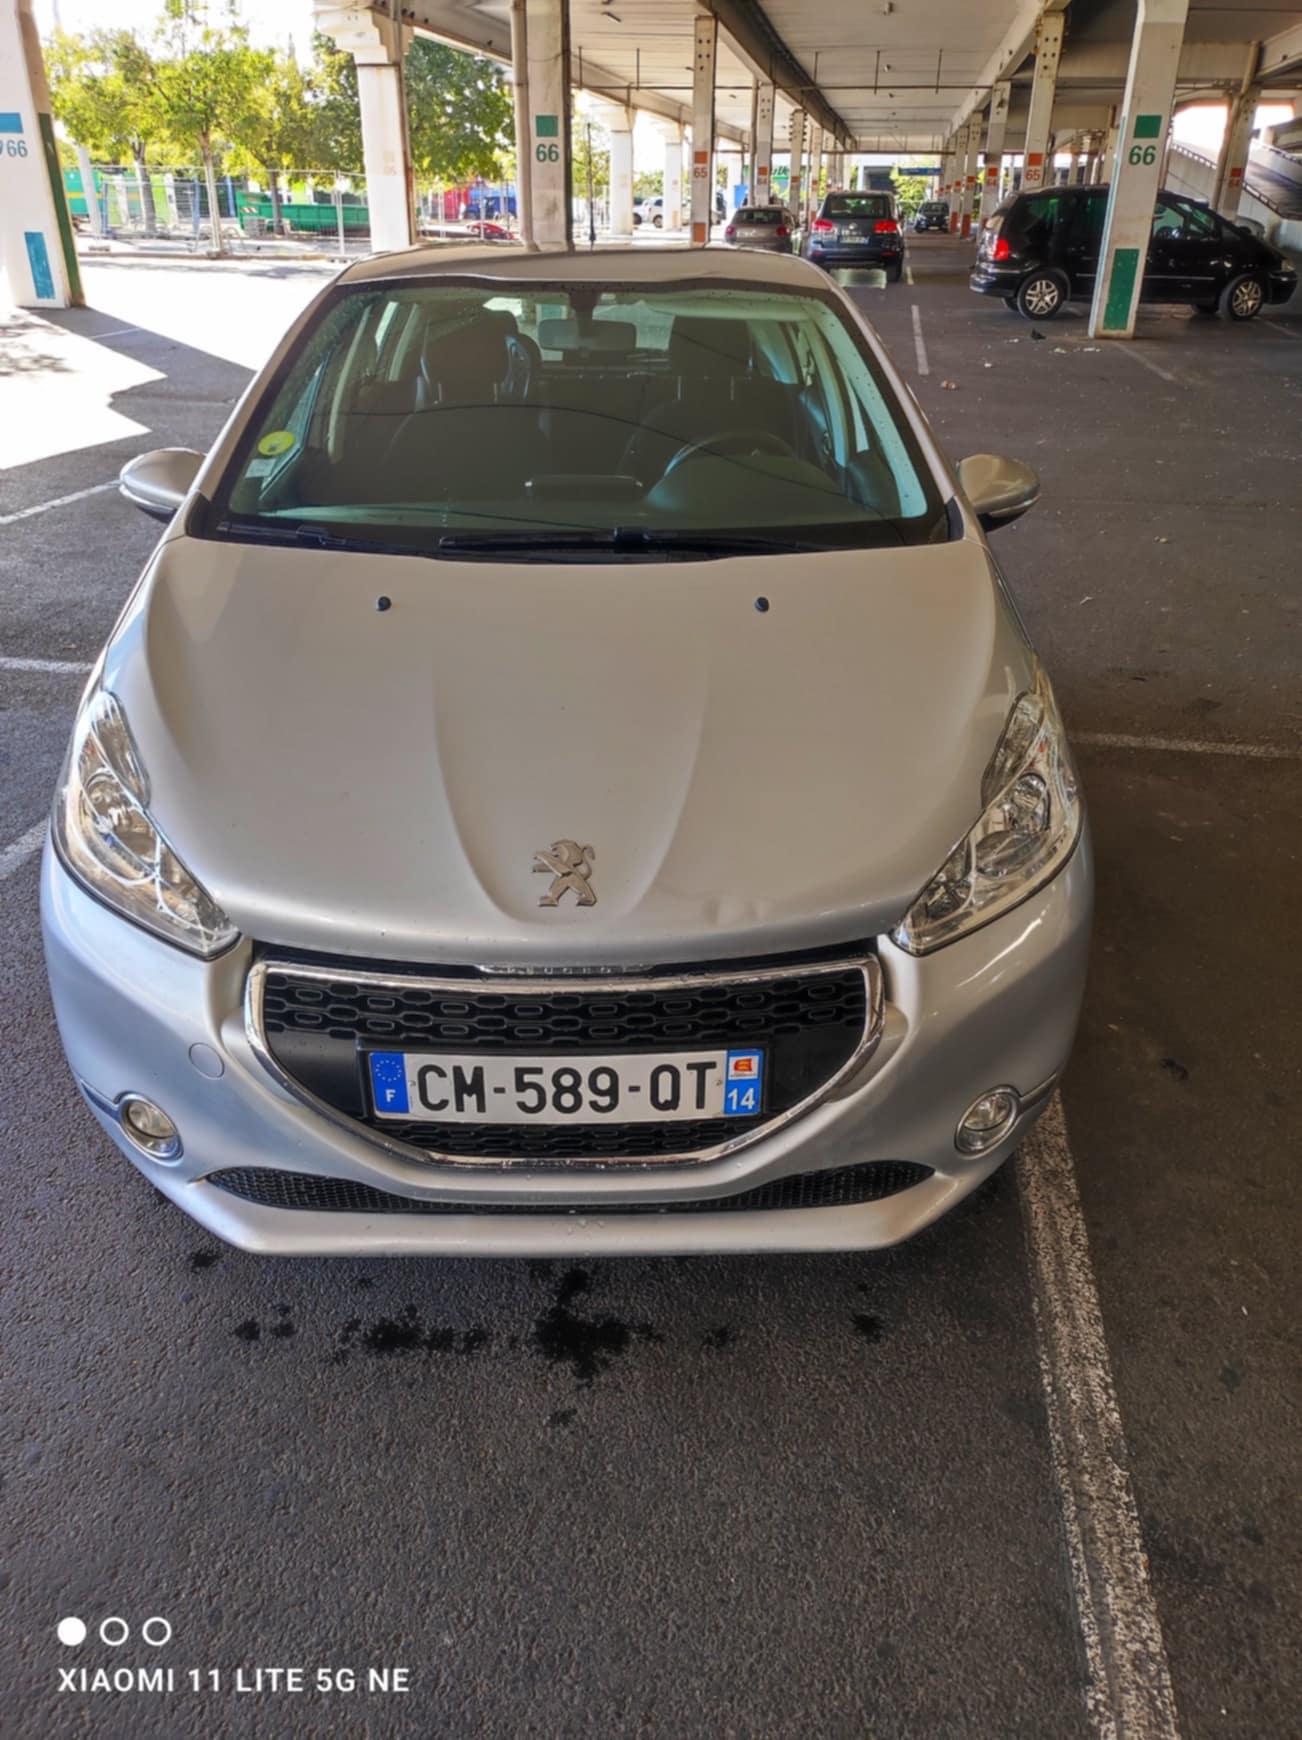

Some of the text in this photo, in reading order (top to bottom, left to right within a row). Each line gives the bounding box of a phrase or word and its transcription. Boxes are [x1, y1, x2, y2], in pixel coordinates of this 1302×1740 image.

[0, 139, 28, 158] 66
[536, 143, 559, 162] 66
[1128, 145, 1157, 165] 66
[1025, 169, 1041, 181] 65
[386, 1089, 396, 1103] F
[416, 1061, 717, 1114] CM-589-QT
[727, 1087, 756, 1111] 14
